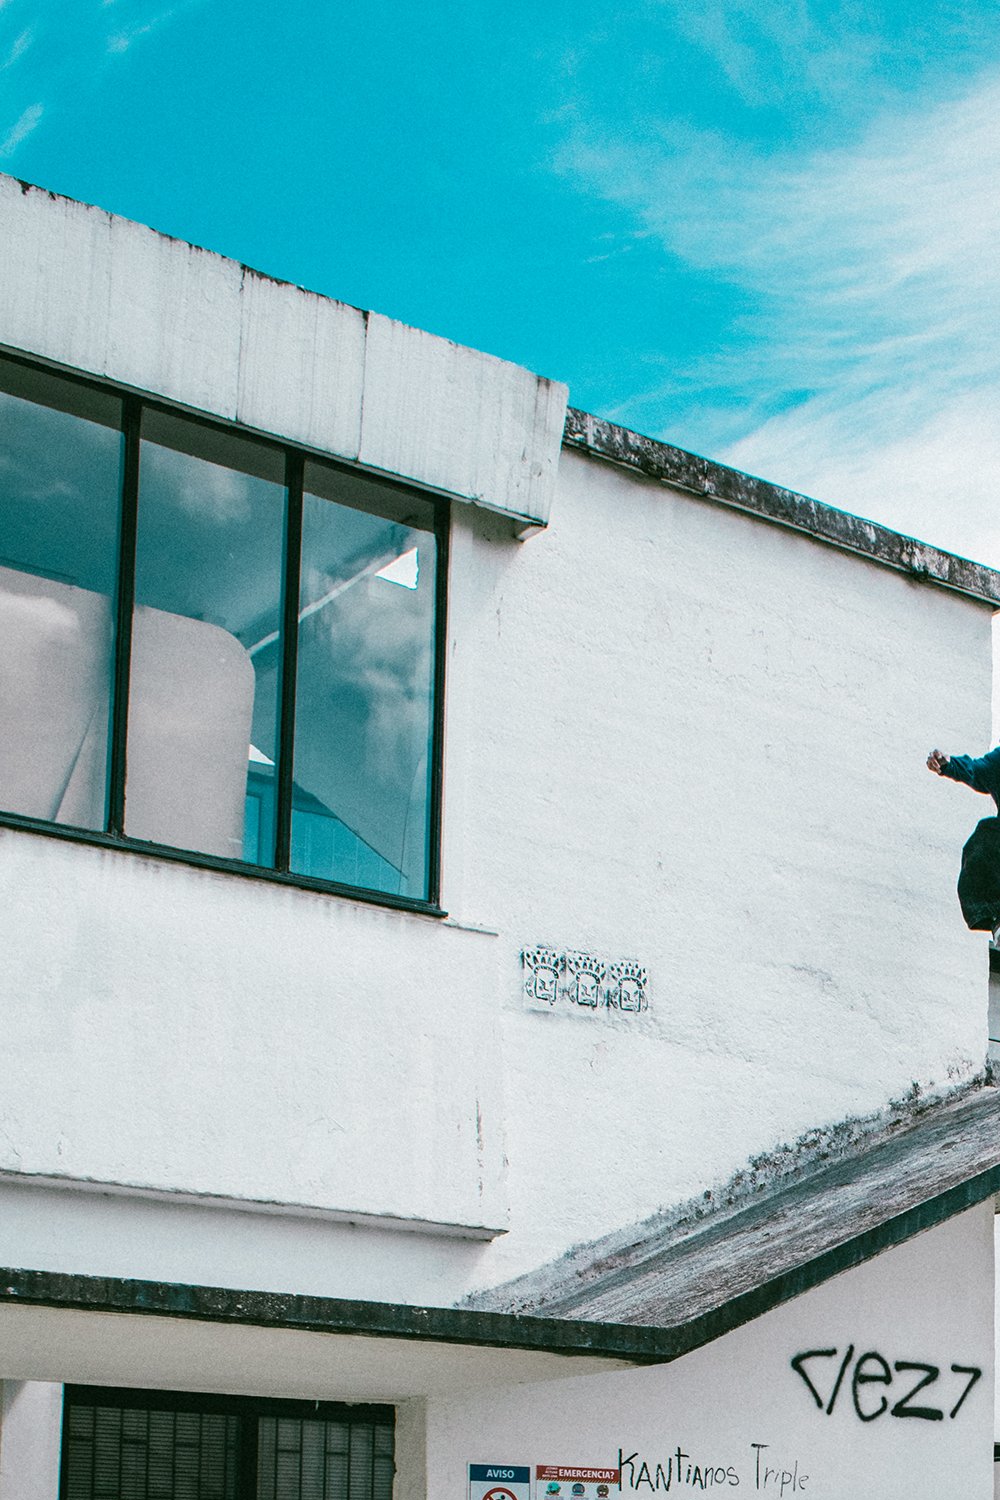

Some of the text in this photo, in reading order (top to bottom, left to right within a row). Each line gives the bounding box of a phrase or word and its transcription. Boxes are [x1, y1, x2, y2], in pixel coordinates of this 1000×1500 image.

[486, 1468, 515, 1479] AVISO
[558, 1468, 615, 1479] EMERGENCIA?
[751, 1443, 809, 1497] Triple
